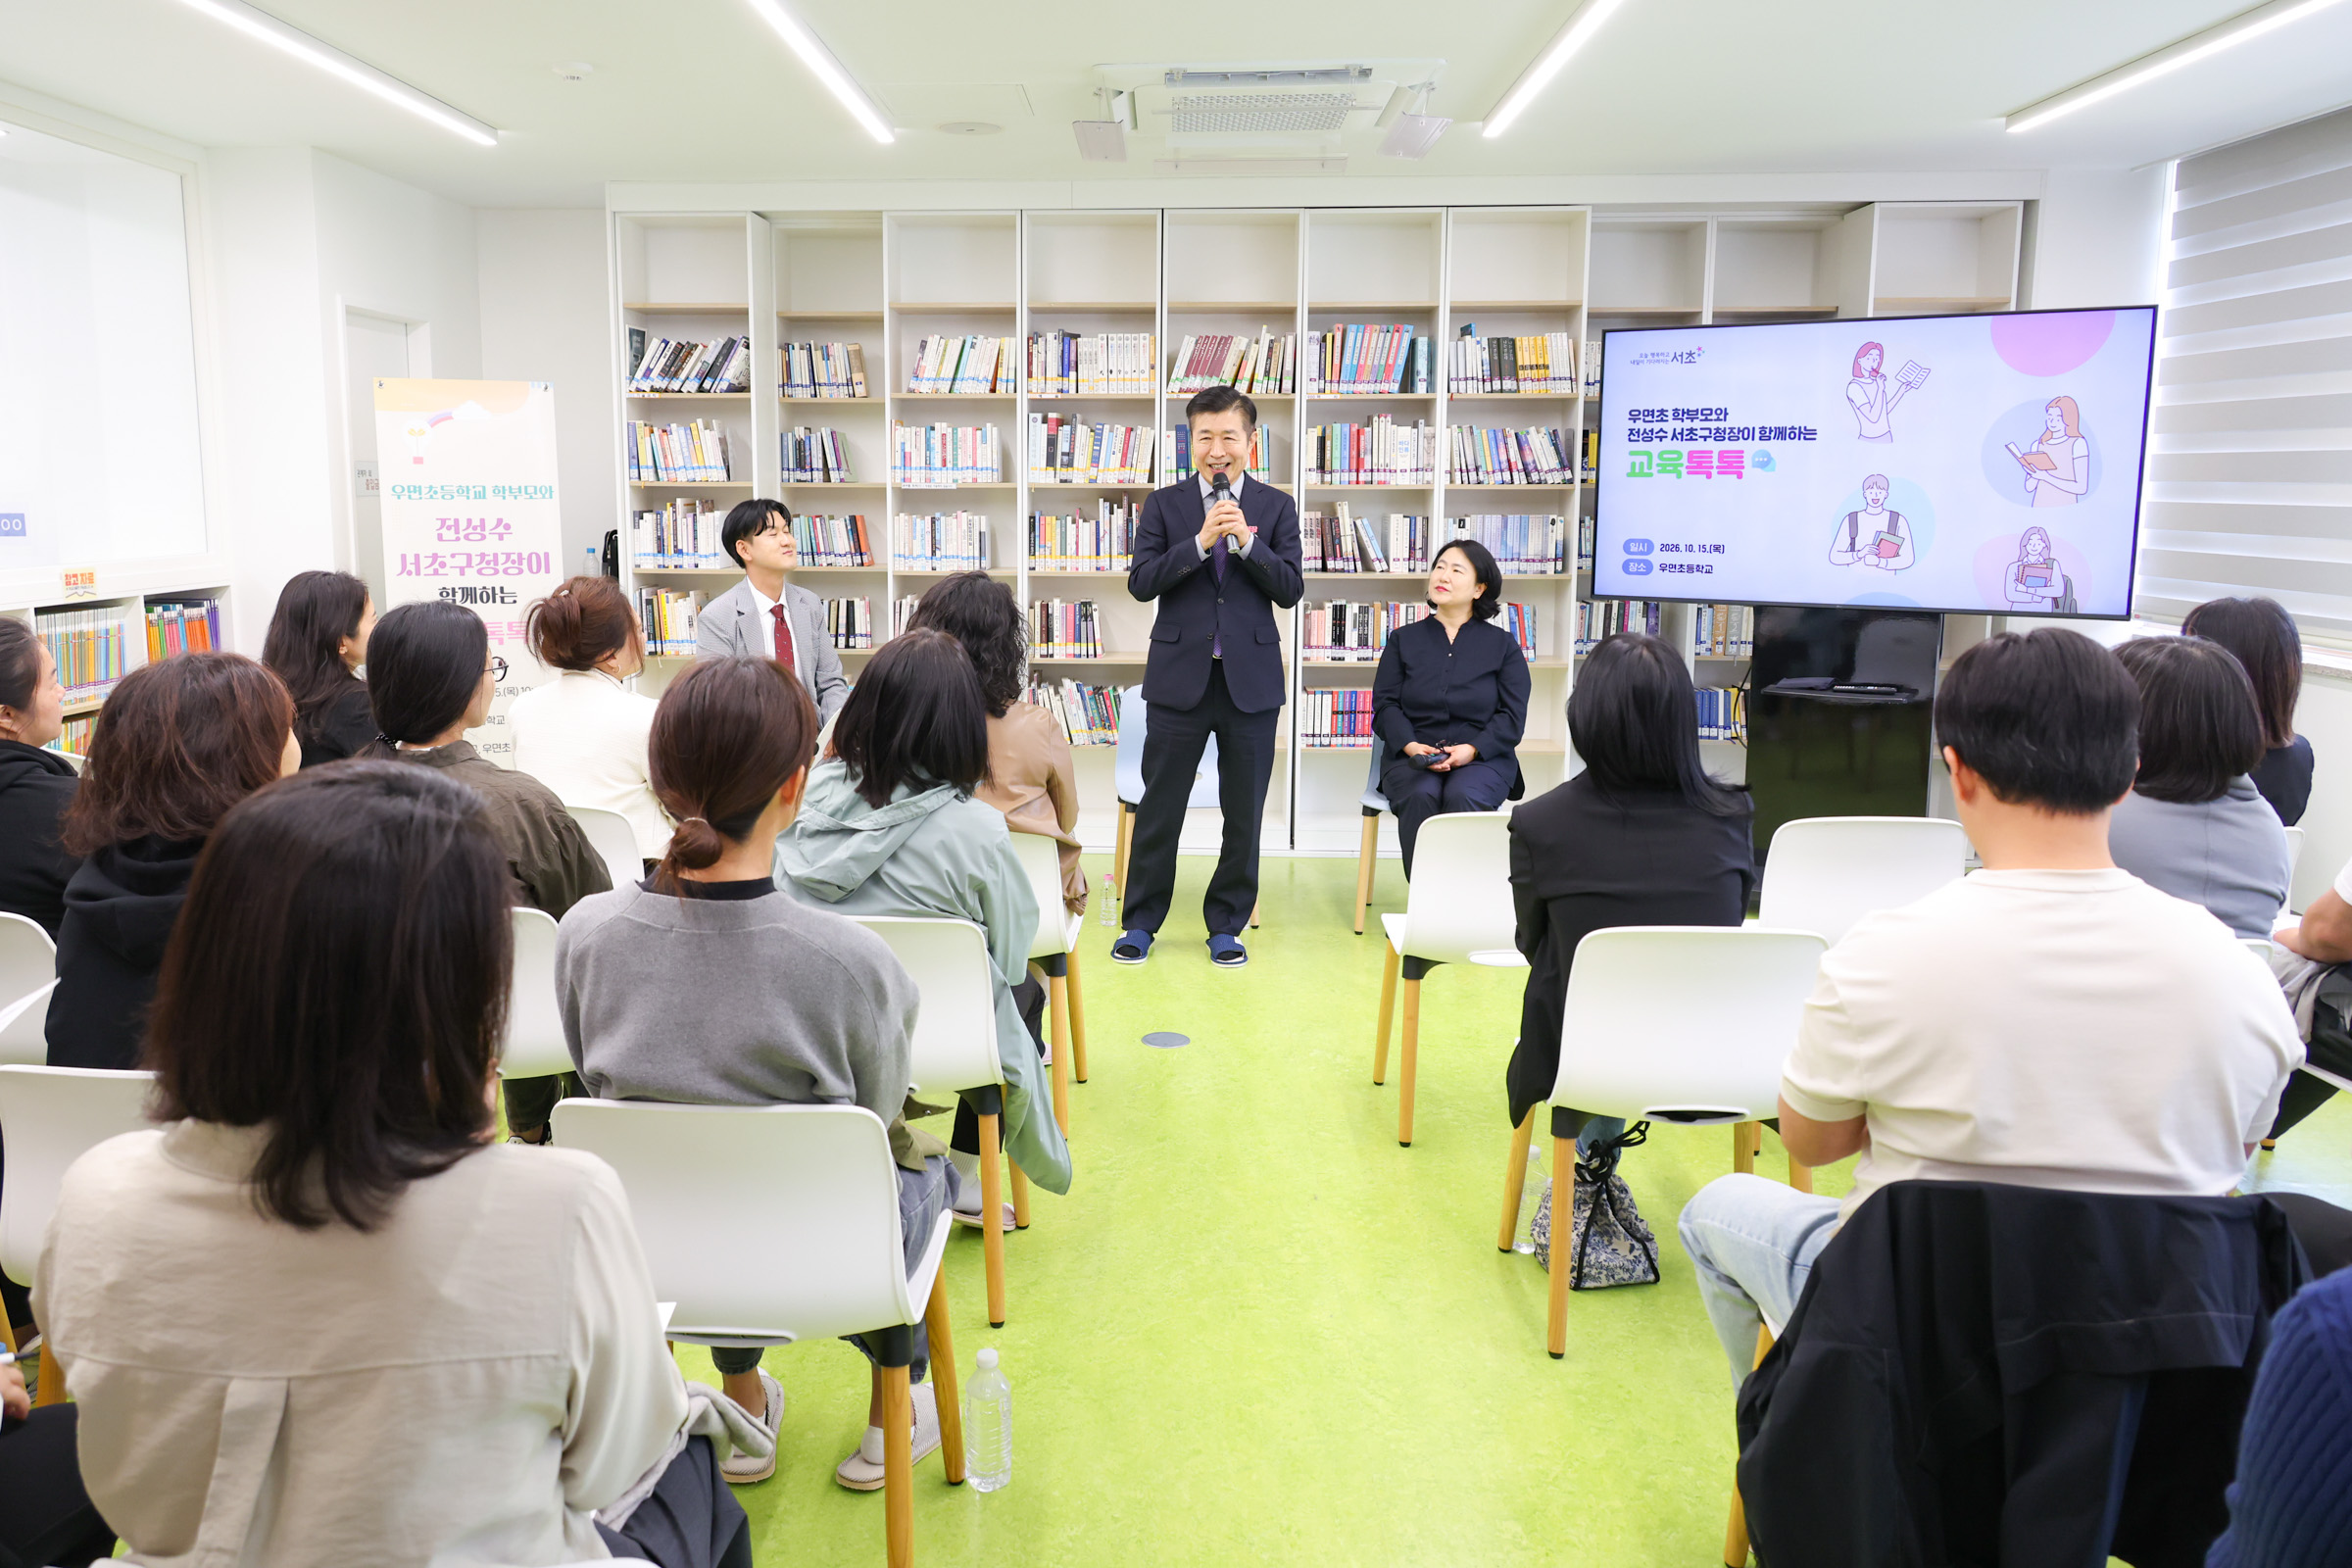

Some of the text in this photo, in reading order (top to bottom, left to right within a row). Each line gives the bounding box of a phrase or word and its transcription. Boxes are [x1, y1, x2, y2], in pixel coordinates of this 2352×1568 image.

[1671, 350, 1696, 365] 서초
[1628, 407, 1729, 423] 우면초 학부모와
[1628, 425, 1818, 443] 전성수 서초구청장이 함께하는
[1626, 449, 1745, 479] 교육톡톡
[391, 484, 555, 501] 우면초등학교 학부모와
[435, 517, 514, 543] 전성수
[1630, 542, 1647, 552] 일시
[1660, 544, 1682, 553] 2026.
[1685, 544, 1695, 553] 10.
[396, 552, 551, 577] 서초구청장이
[1629, 563, 1713, 573] 장소 우면초등학교
[65, 572, 94, 586] 참고 자료
[438, 586, 517, 605] 함께하는
[482, 714, 506, 726] 학교
